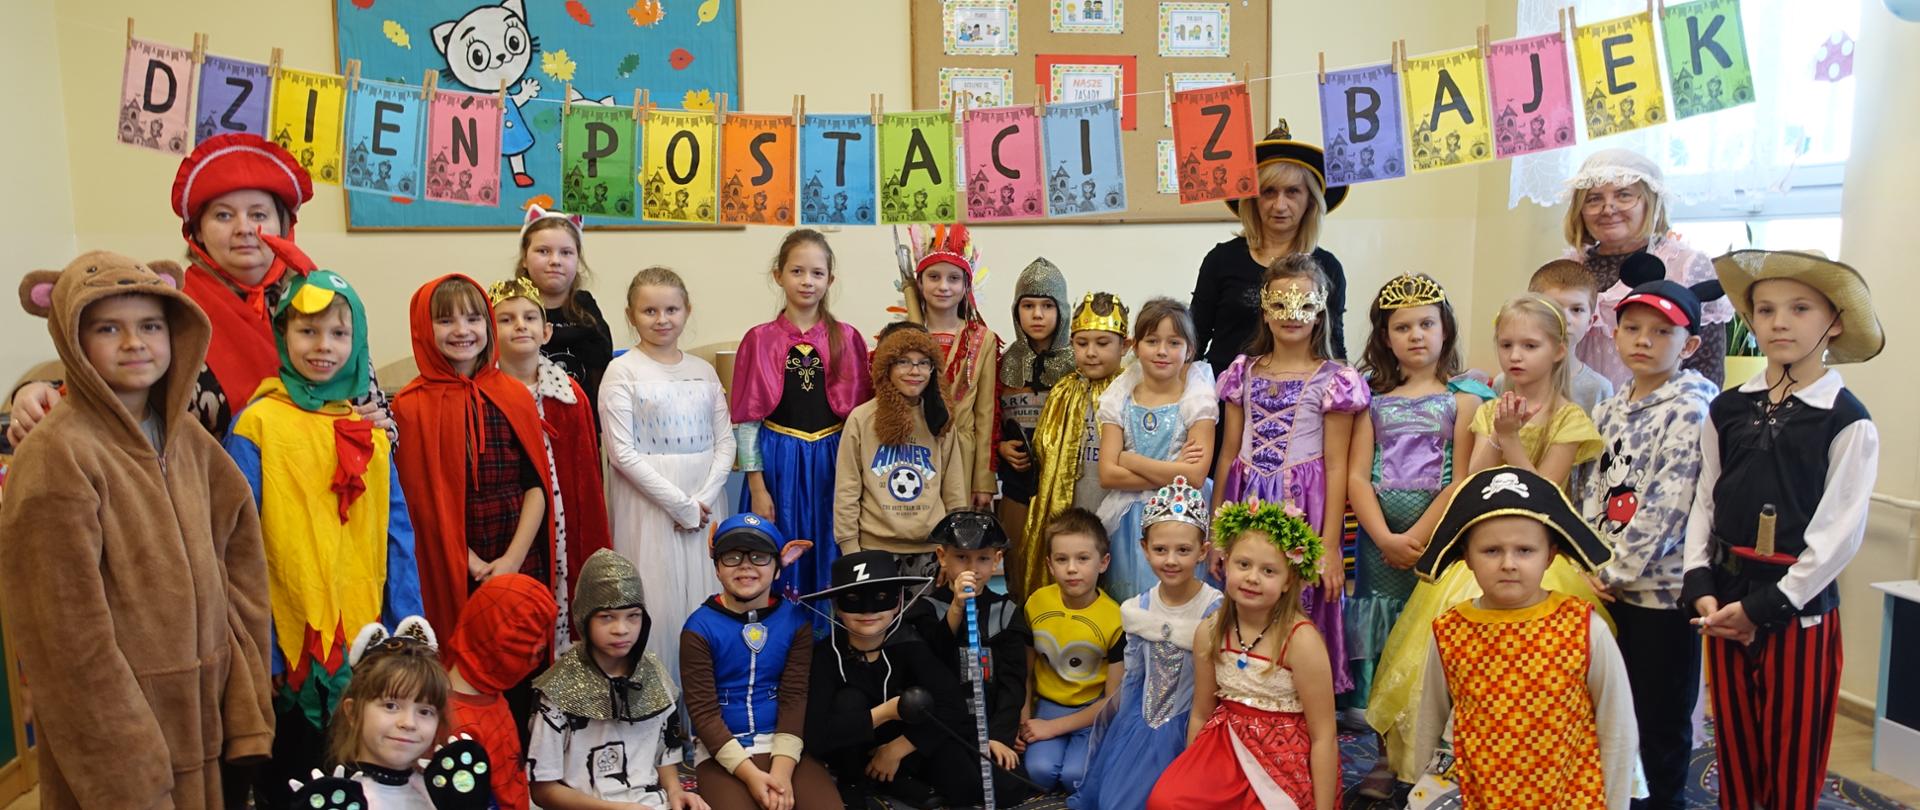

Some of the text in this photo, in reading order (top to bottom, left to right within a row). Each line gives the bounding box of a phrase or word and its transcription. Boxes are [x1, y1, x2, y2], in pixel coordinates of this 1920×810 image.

[1073, 79, 1103, 88] NASZE
[142, 14, 1734, 187] DZIEŃ POSTACI Z BAJEK
[871, 444, 936, 480] WINNER
[852, 562, 870, 581] Z
